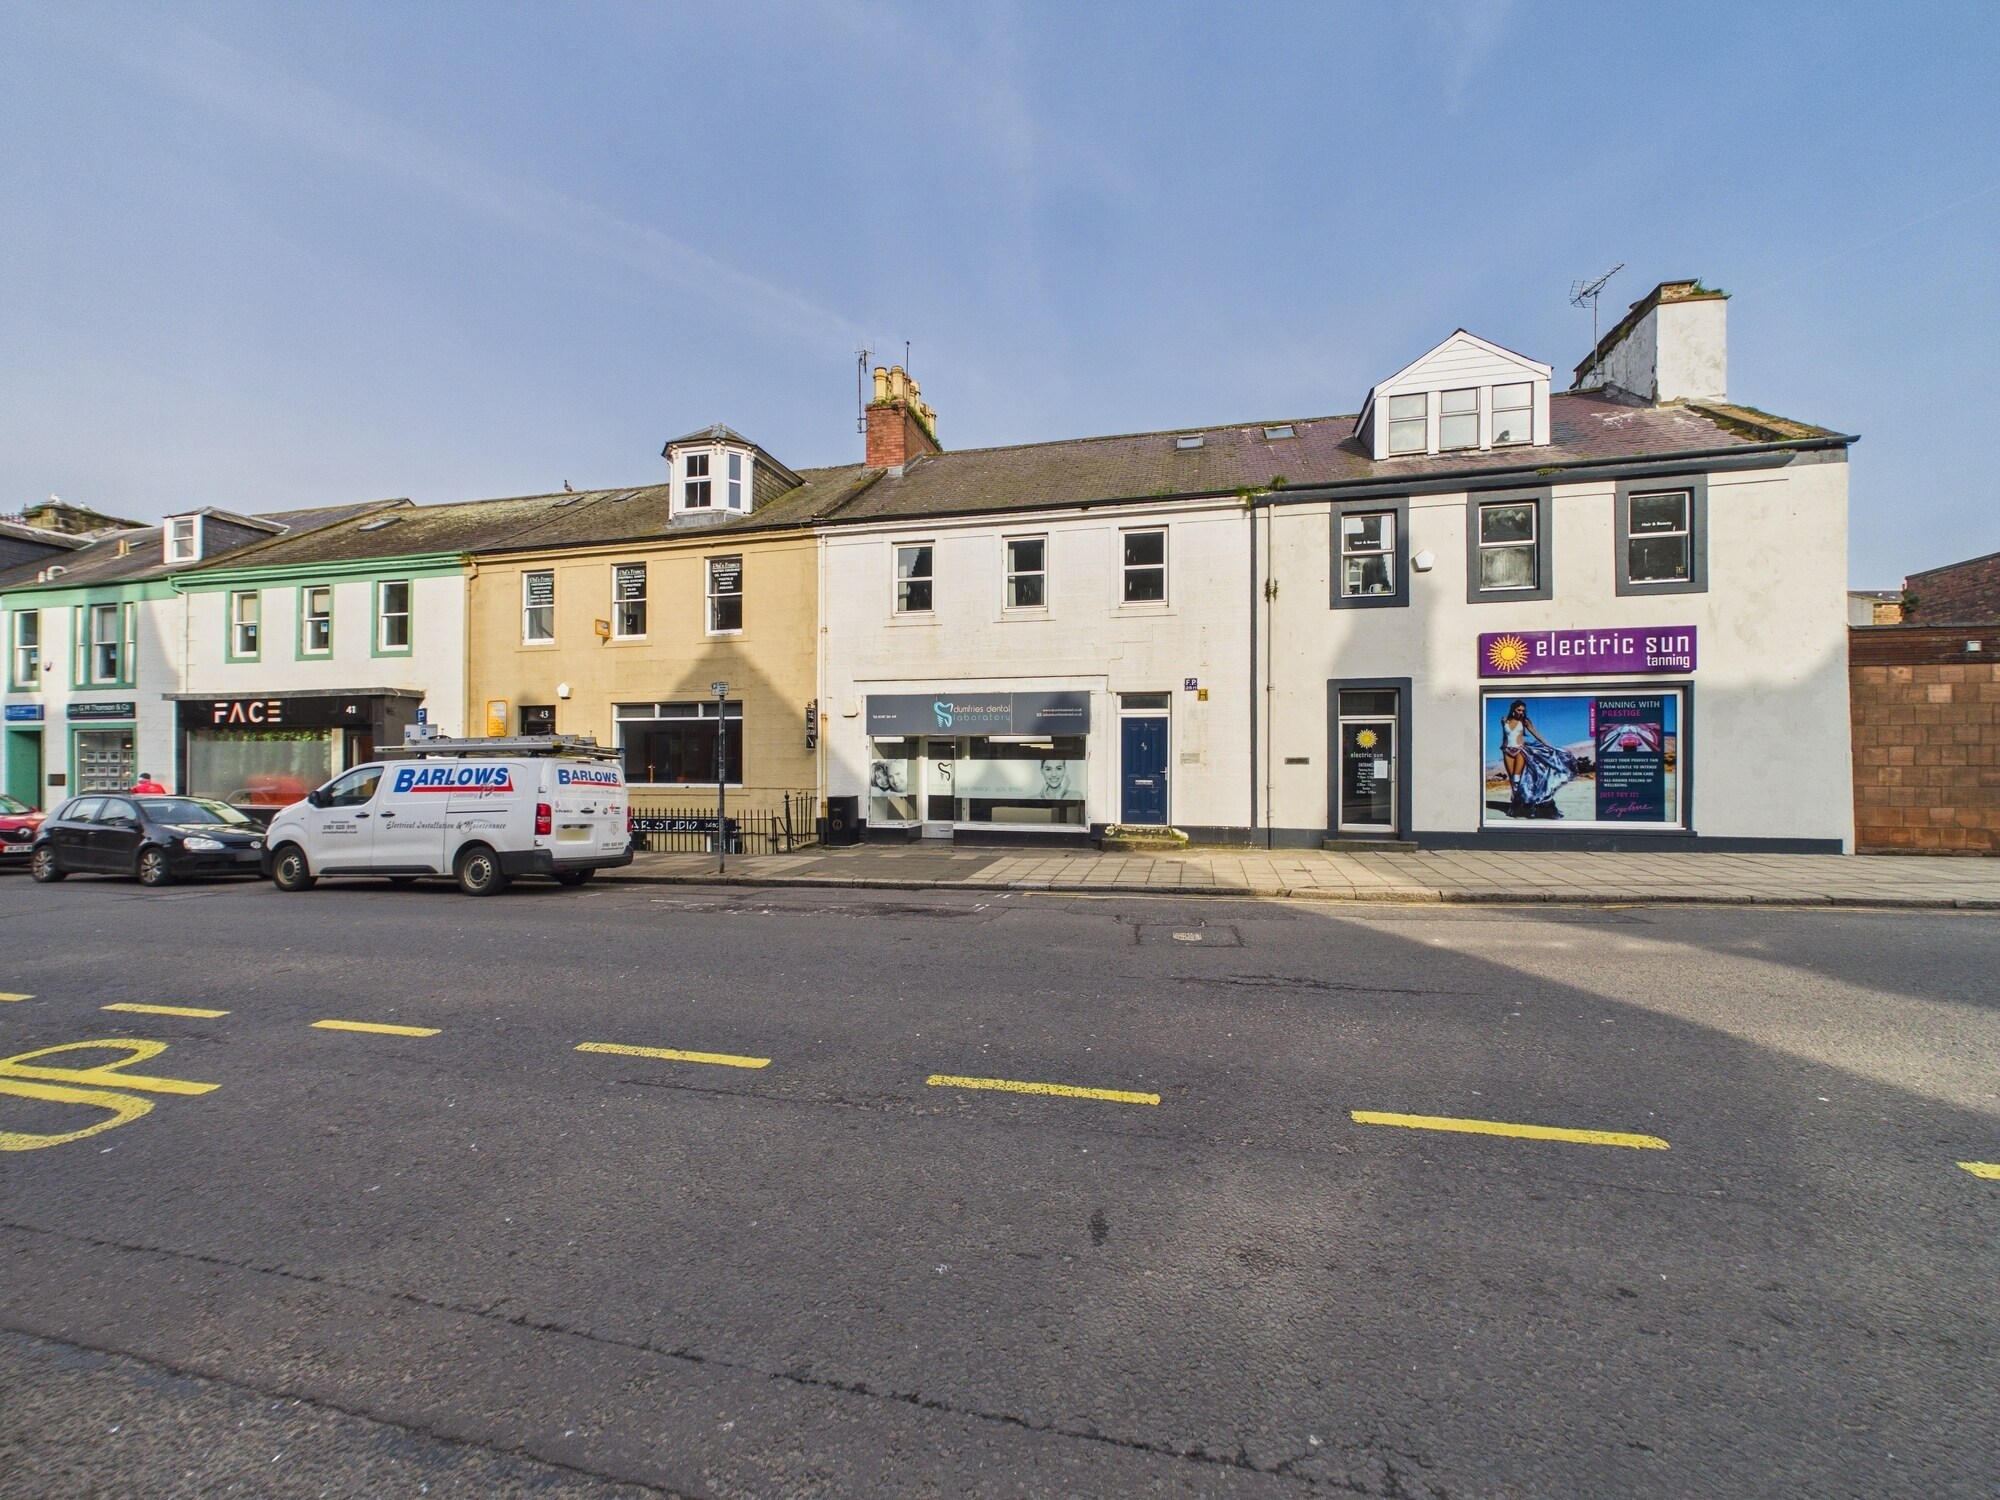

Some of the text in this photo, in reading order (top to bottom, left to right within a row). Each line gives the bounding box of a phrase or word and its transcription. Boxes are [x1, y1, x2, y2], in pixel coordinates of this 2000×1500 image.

[1536, 632, 1690, 656] electric sun
[1647, 654, 1690, 668] tanning
[346, 705, 356, 714] 41
[954, 704, 1010, 713] dumfries dental
[1599, 701, 1636, 709] TANNING
[214, 702, 282, 724] FACE
[954, 714, 1010, 722] laboratory
[393, 767, 509, 792] BARLOWS
[558, 769, 617, 784] BARLOWS
[386, 821, 416, 830] Electrical
[417, 821, 454, 829] Installation
